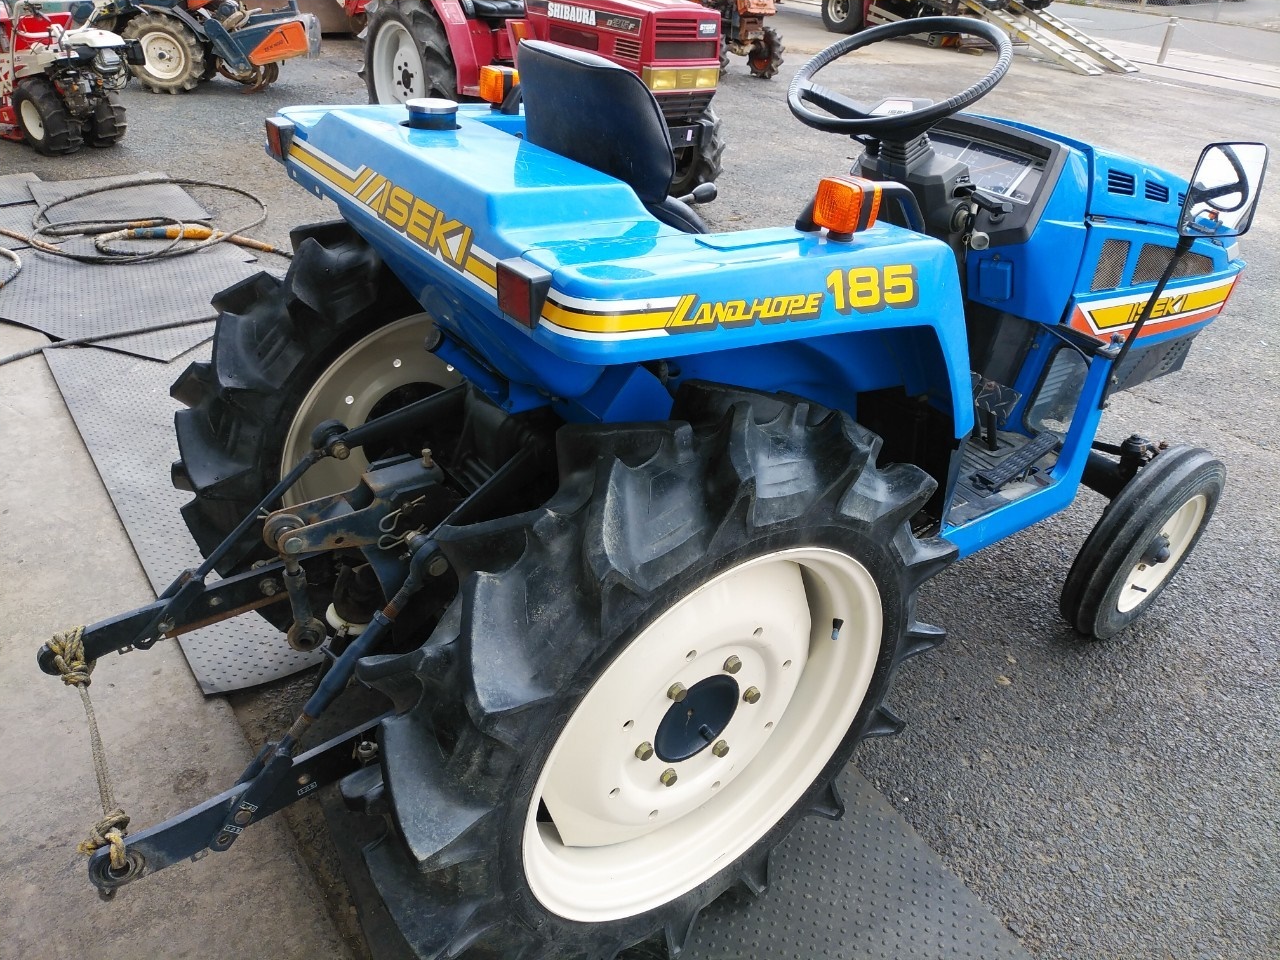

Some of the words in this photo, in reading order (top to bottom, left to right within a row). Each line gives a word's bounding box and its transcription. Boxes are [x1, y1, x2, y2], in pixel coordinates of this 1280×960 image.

[547, 2, 596, 26] SHIBAURA
[377, 178, 474, 272] ISEKI
[826, 263, 919, 315] 185
[1128, 294, 1188, 323] ISEKI
